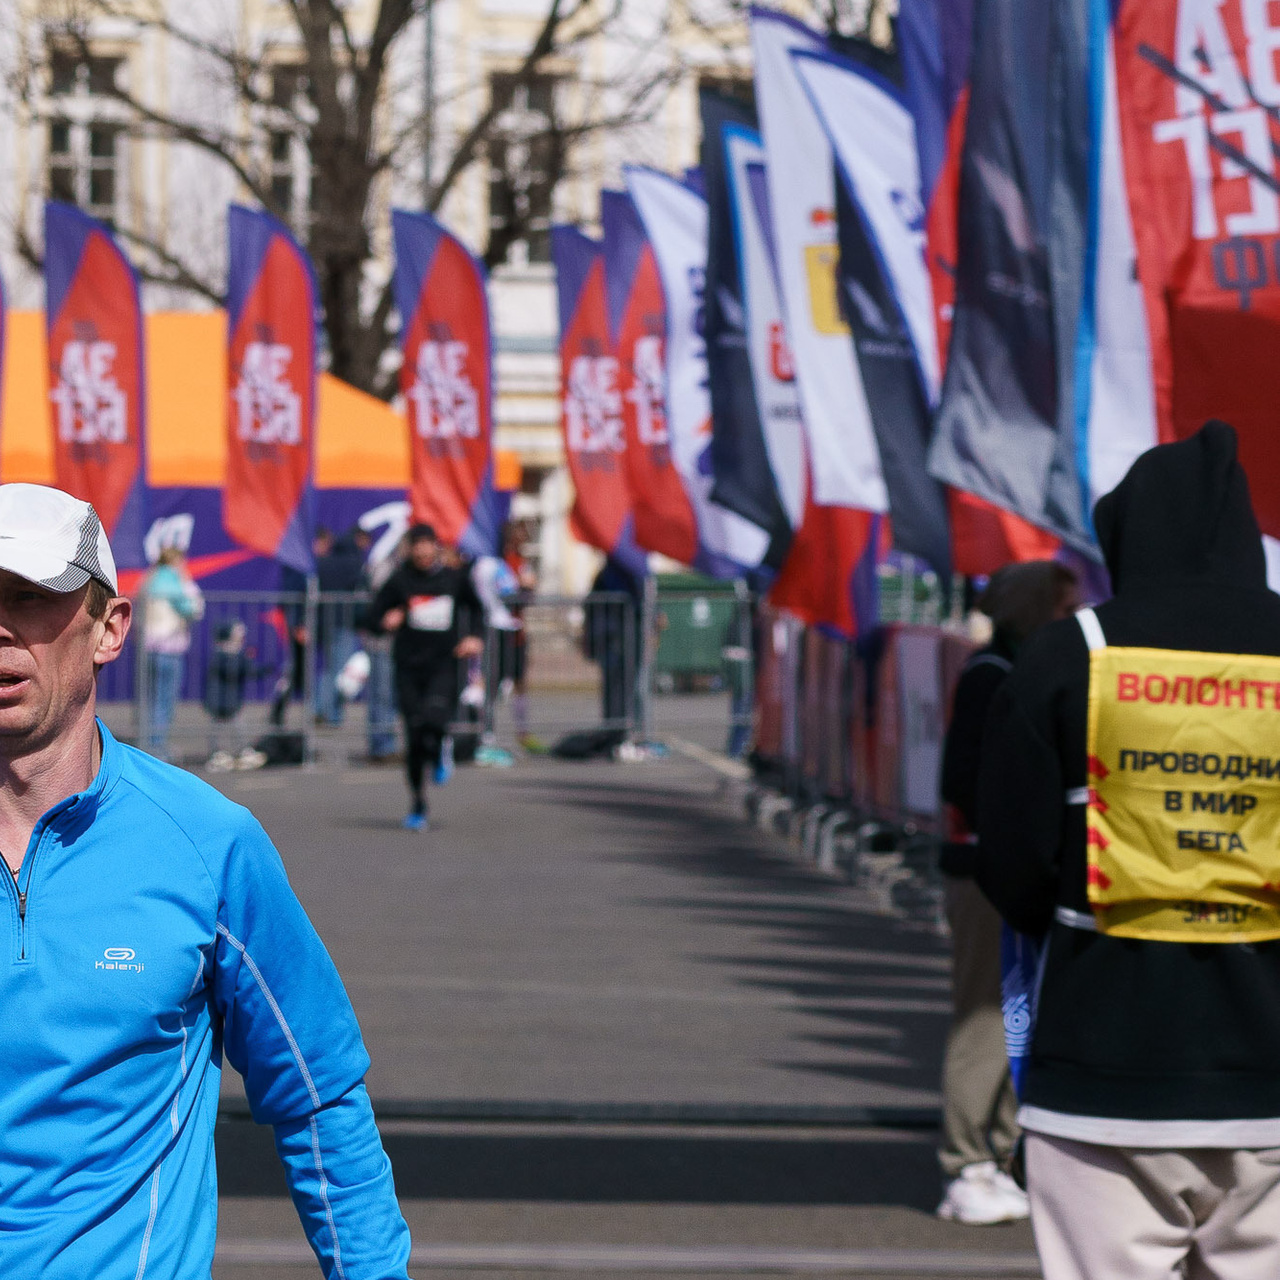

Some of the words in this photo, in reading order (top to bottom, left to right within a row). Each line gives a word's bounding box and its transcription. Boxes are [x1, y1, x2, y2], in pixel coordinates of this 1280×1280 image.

[1118, 672, 1280, 710] ВОЛОНТ
[1164, 790, 1183, 812] В
[1192, 791, 1258, 815] МИР
[1177, 830, 1247, 852] БЕГА
[95, 960, 144, 973] Kalenji
